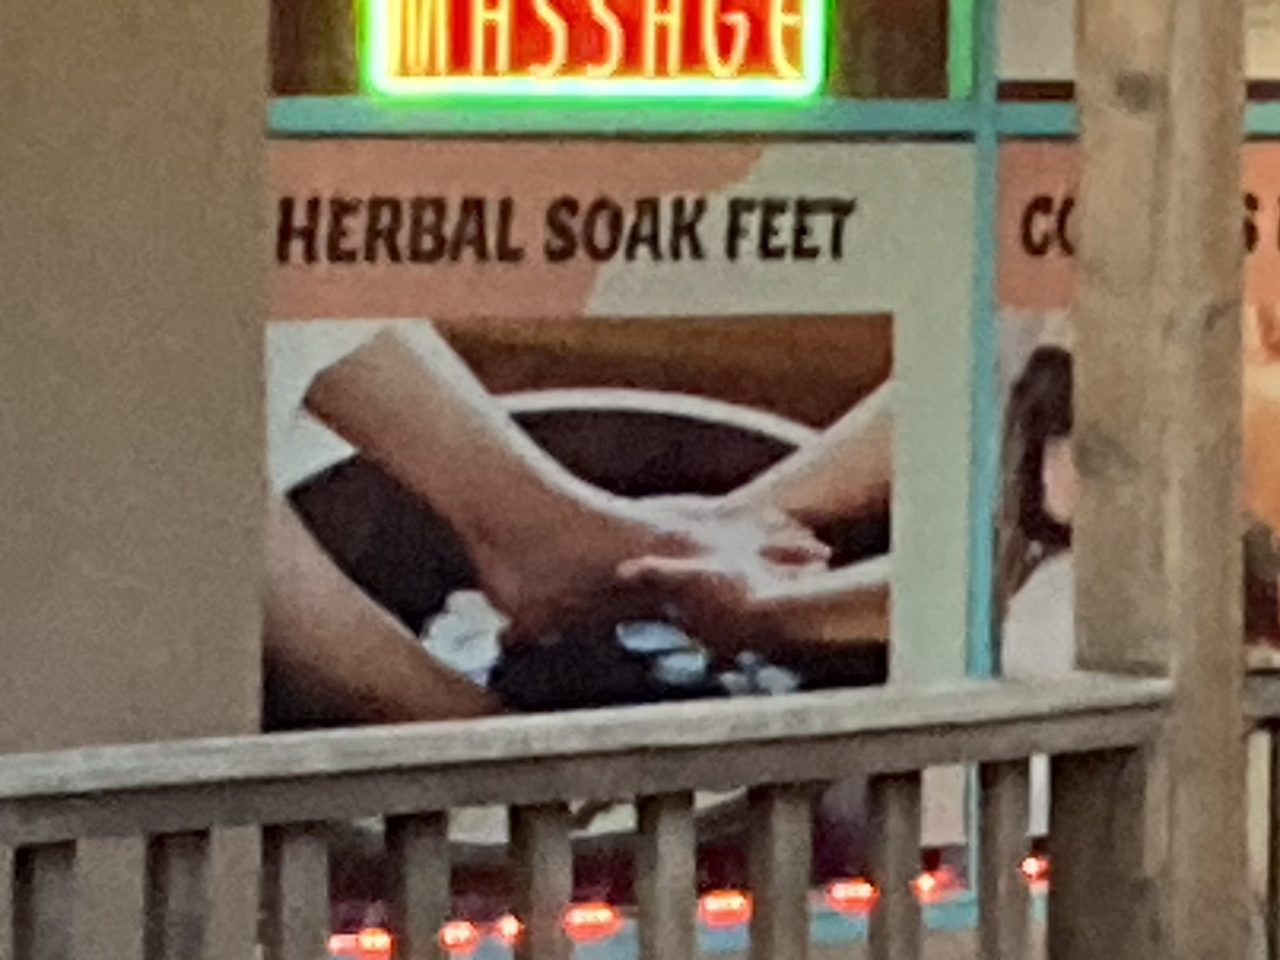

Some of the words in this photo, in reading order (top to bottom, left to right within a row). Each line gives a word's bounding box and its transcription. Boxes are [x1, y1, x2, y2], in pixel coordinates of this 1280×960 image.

[275, 196, 525, 264] HERBAL
[544, 196, 707, 264] SOAK
[724, 196, 857, 262] FEET
